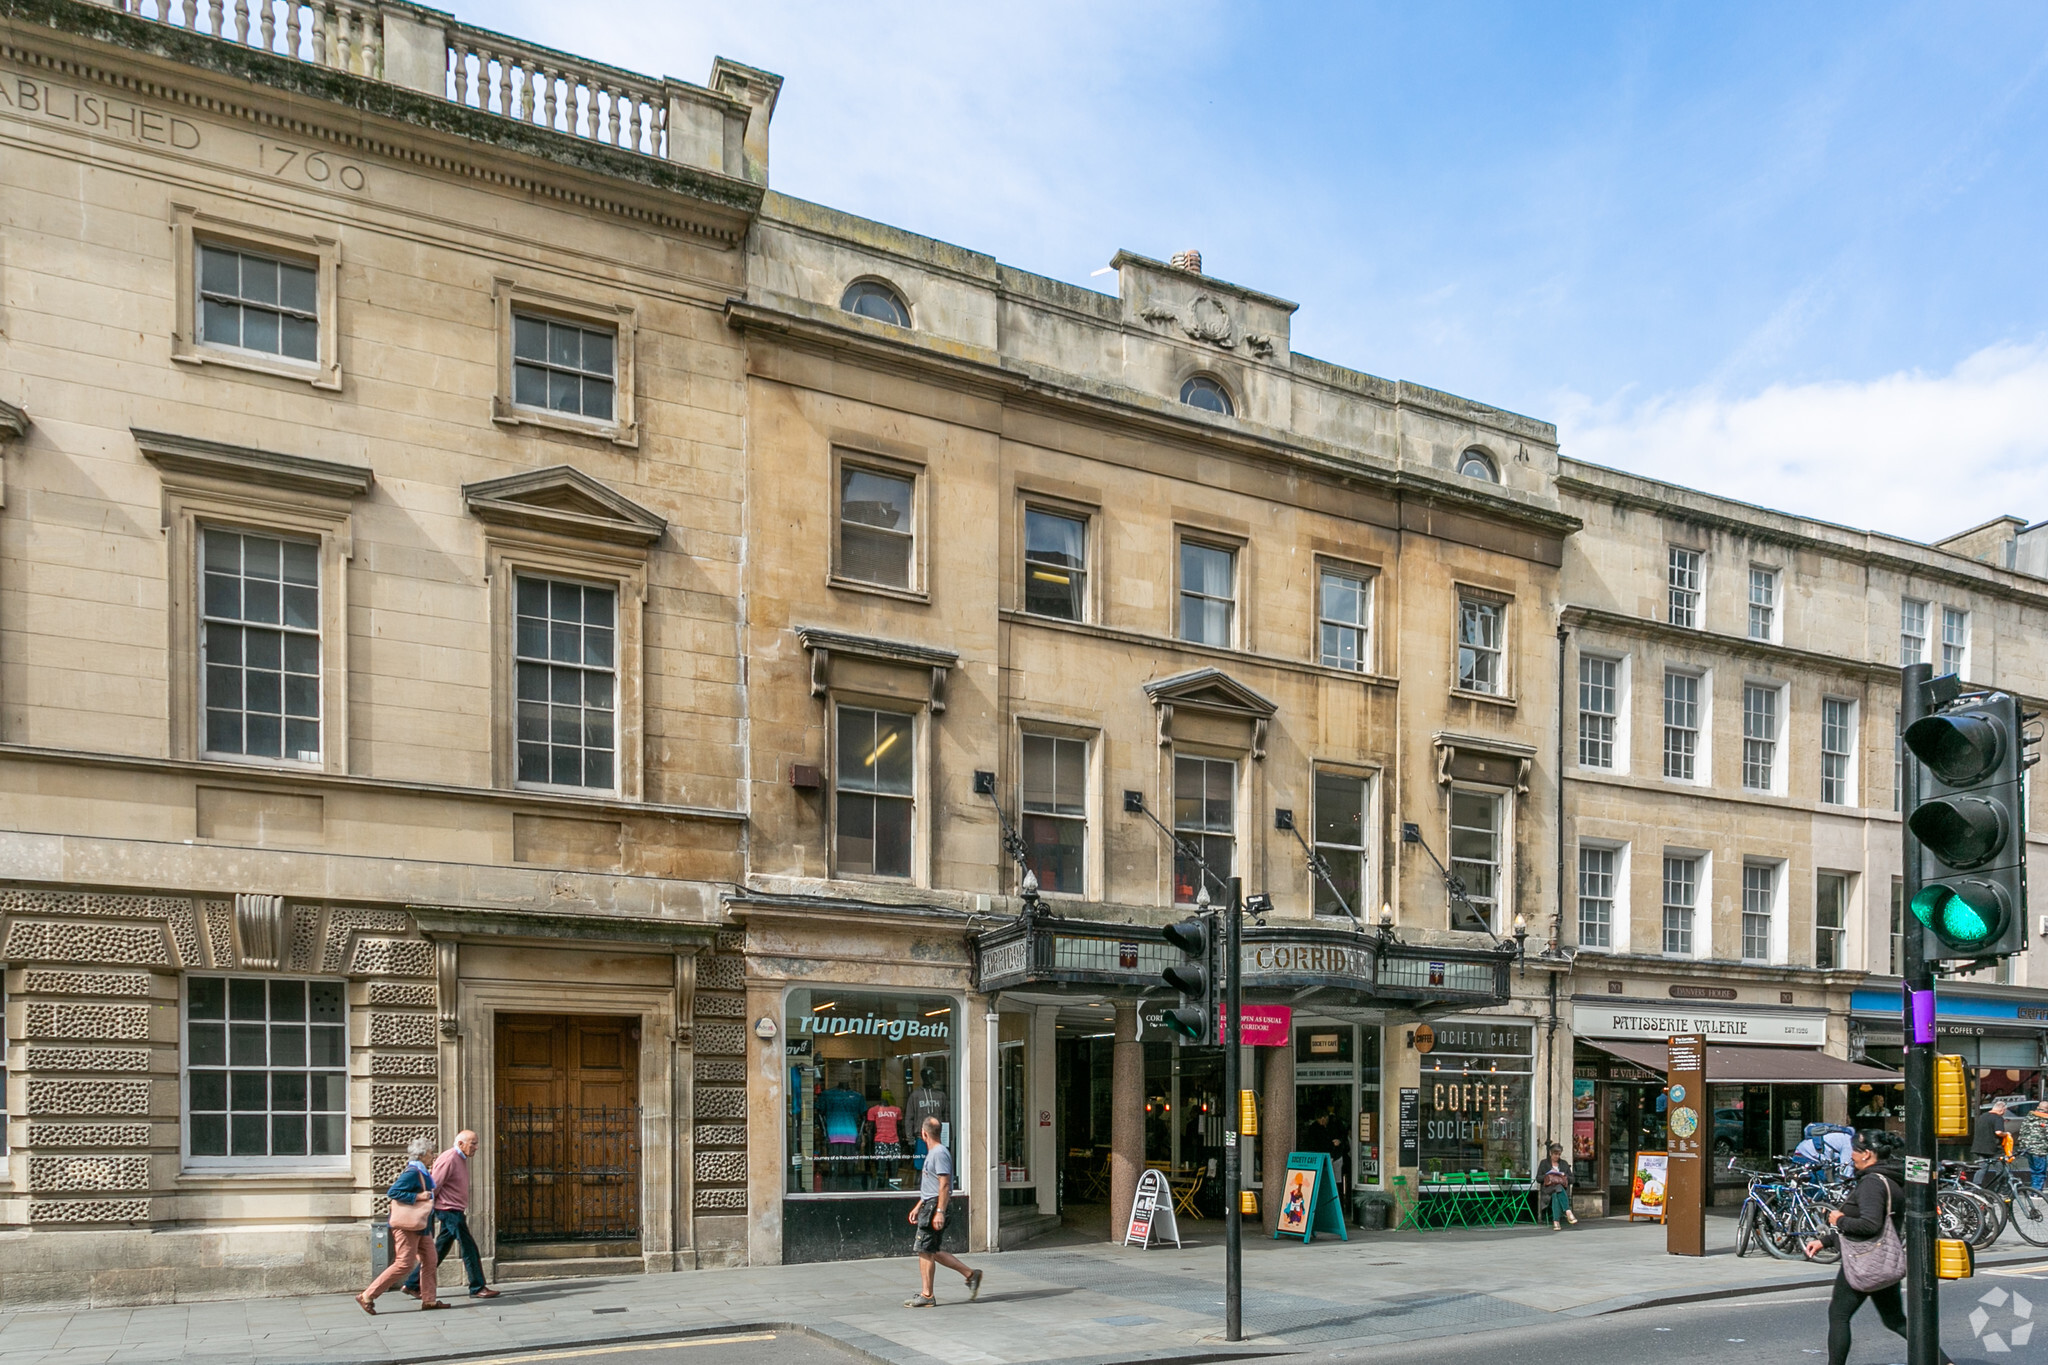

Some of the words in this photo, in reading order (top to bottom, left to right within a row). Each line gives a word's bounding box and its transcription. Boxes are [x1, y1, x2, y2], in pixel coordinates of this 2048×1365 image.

[259, 143, 366, 191] 1760
[982, 943, 1026, 976] CORRIDOR
[1256, 946, 1367, 979] CORRIDOR
[1610, 983, 1621, 992] 20
[1677, 987, 1706, 997] DANVERS
[1708, 989, 1731, 998] HOUSE
[1613, 1015, 1688, 1032] PATISSERIE
[1694, 1019, 1747, 1035] VALERIE
[1950, 1026, 1973, 1035] COFFEE
[1417, 1033, 1433, 1043] COFFEE
[1441, 1030, 1483, 1046] OCIETY
[1434, 1083, 1509, 1112] COFFEE
[1428, 1120, 1485, 1140] SOCIETY
